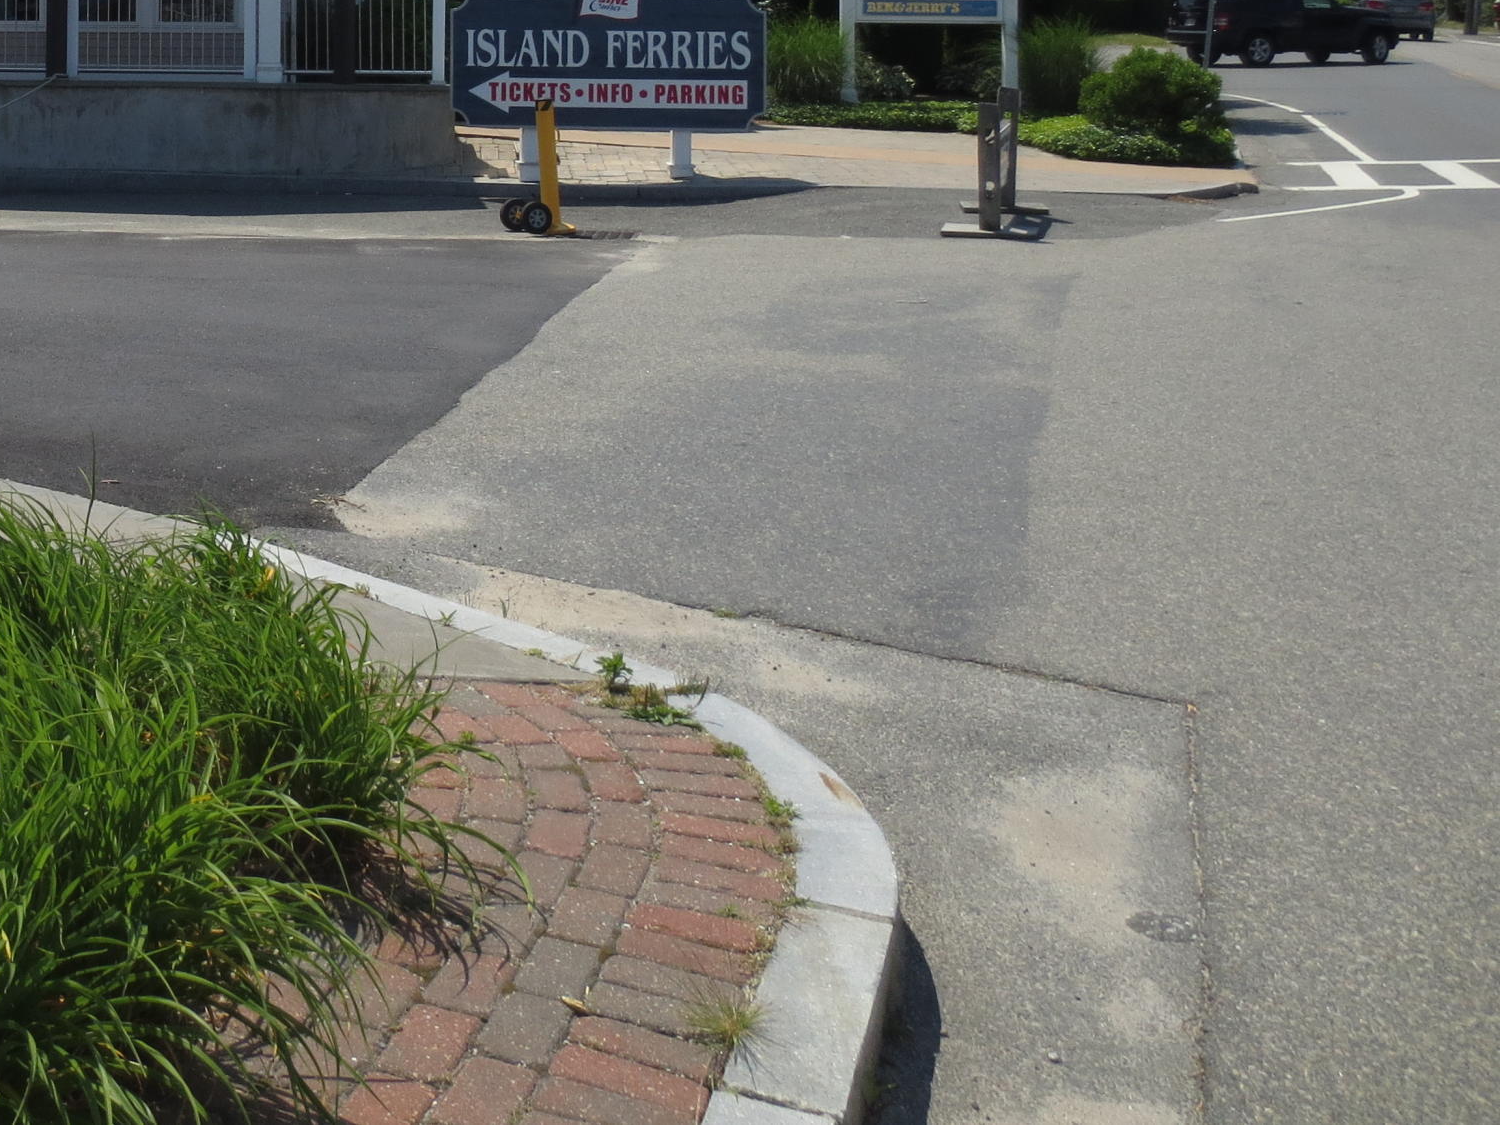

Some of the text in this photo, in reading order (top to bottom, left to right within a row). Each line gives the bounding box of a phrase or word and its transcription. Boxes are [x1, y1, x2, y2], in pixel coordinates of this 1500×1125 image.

[466, 29, 751, 70] ISLAND FERRIES
[488, 82, 744, 105] TICKETS INFO PARKING
